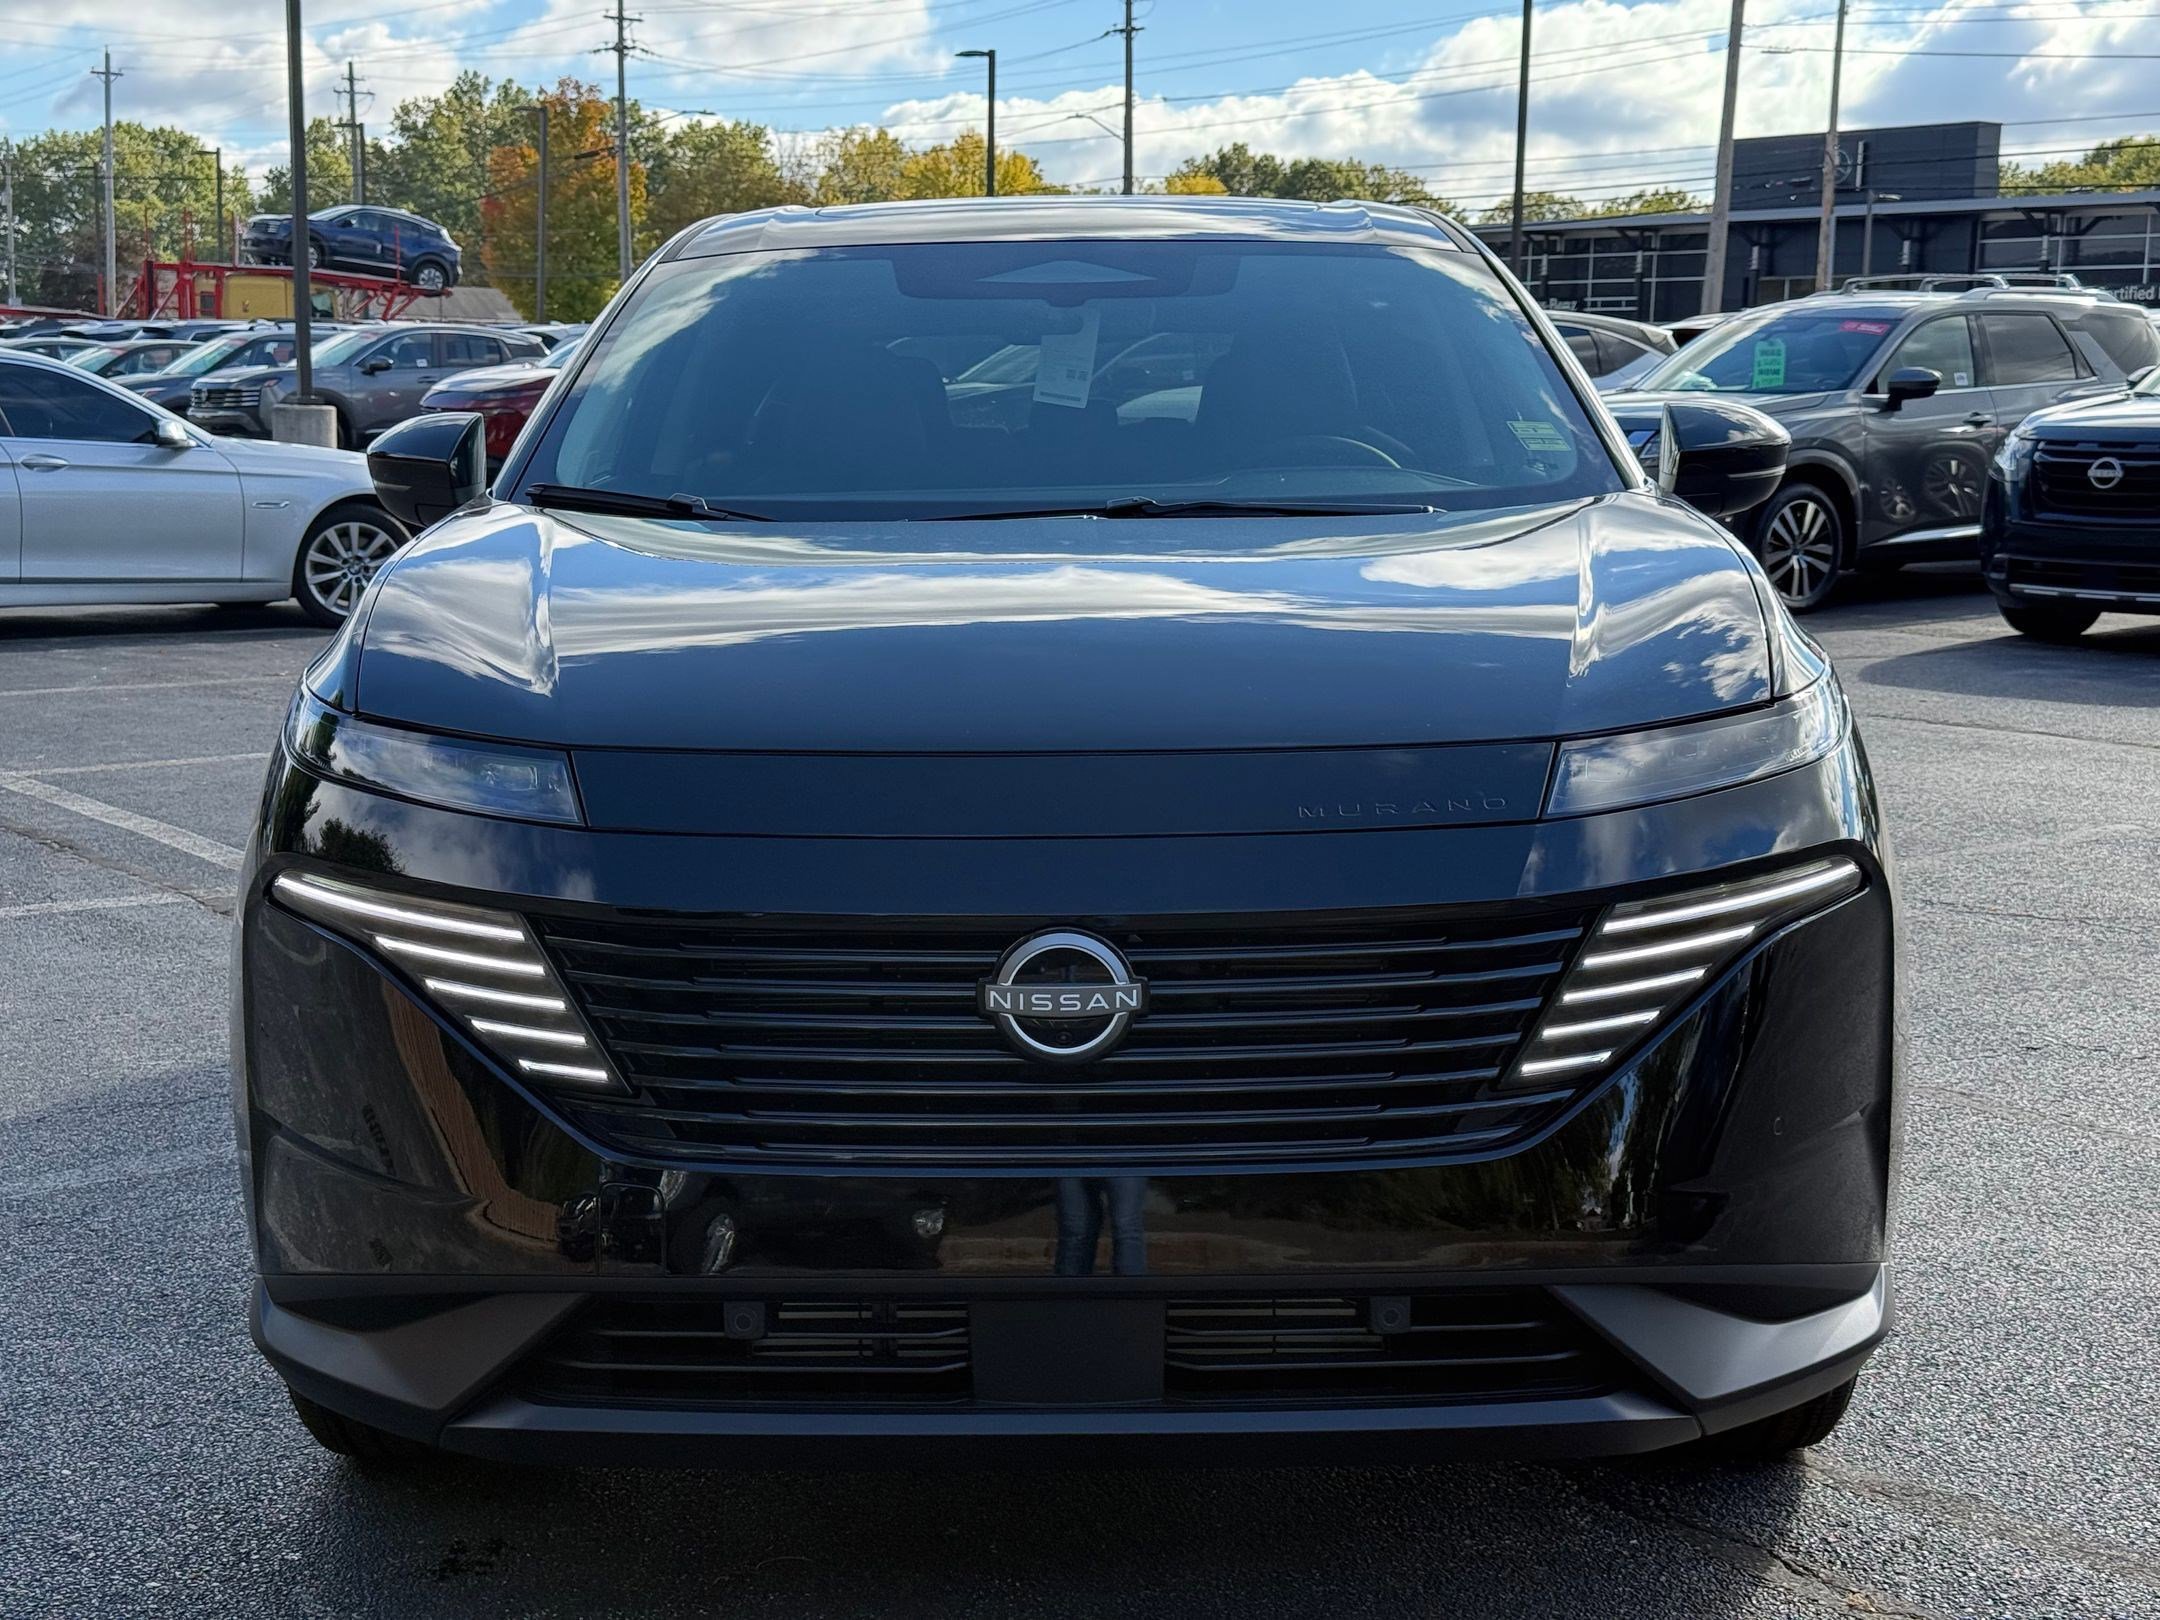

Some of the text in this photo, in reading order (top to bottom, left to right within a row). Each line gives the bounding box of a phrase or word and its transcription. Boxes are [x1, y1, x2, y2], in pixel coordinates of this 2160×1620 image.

[2106, 285, 2155, 301] rtified
[1298, 798, 1507, 818] MURANO
[989, 989, 1138, 1011] NISSAN
